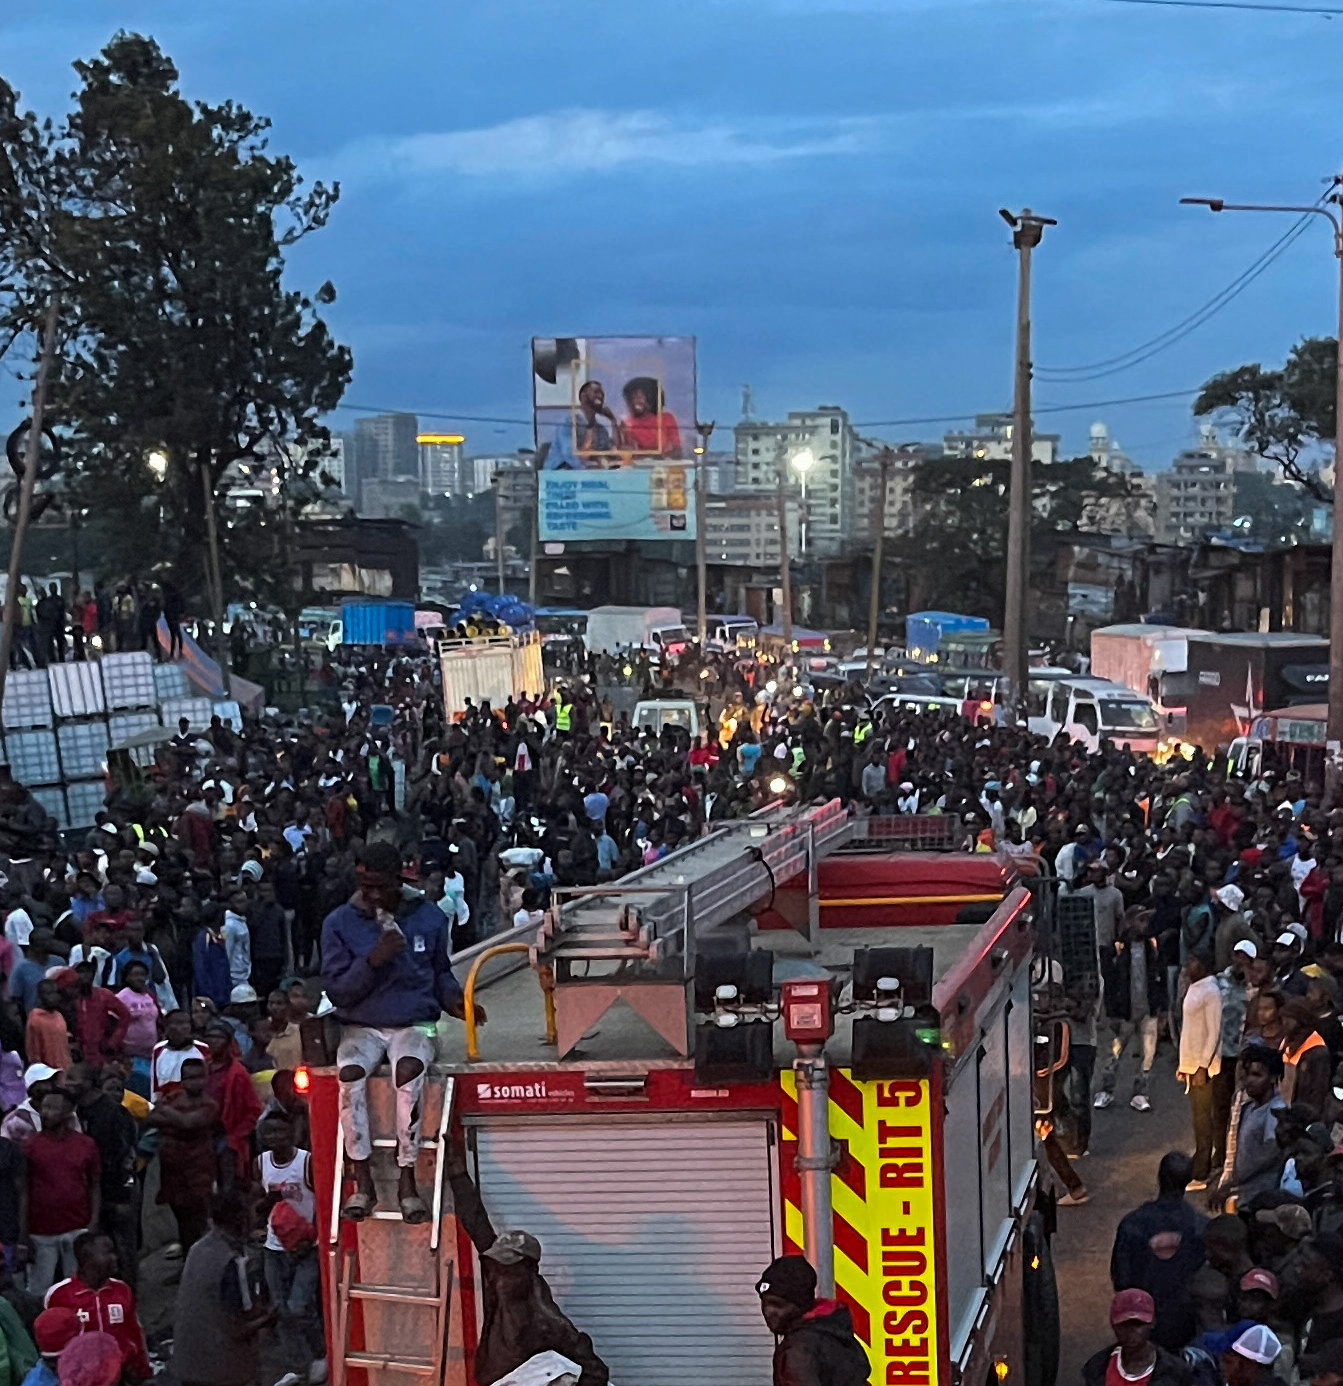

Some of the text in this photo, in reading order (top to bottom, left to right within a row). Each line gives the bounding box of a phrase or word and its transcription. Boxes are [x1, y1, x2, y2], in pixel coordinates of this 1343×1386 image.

[494, 1081, 546, 1098] somati
[876, 1080, 923, 1108] 5
[878, 1119, 925, 1189] RIT
[880, 1226, 930, 1386] RESCUE
